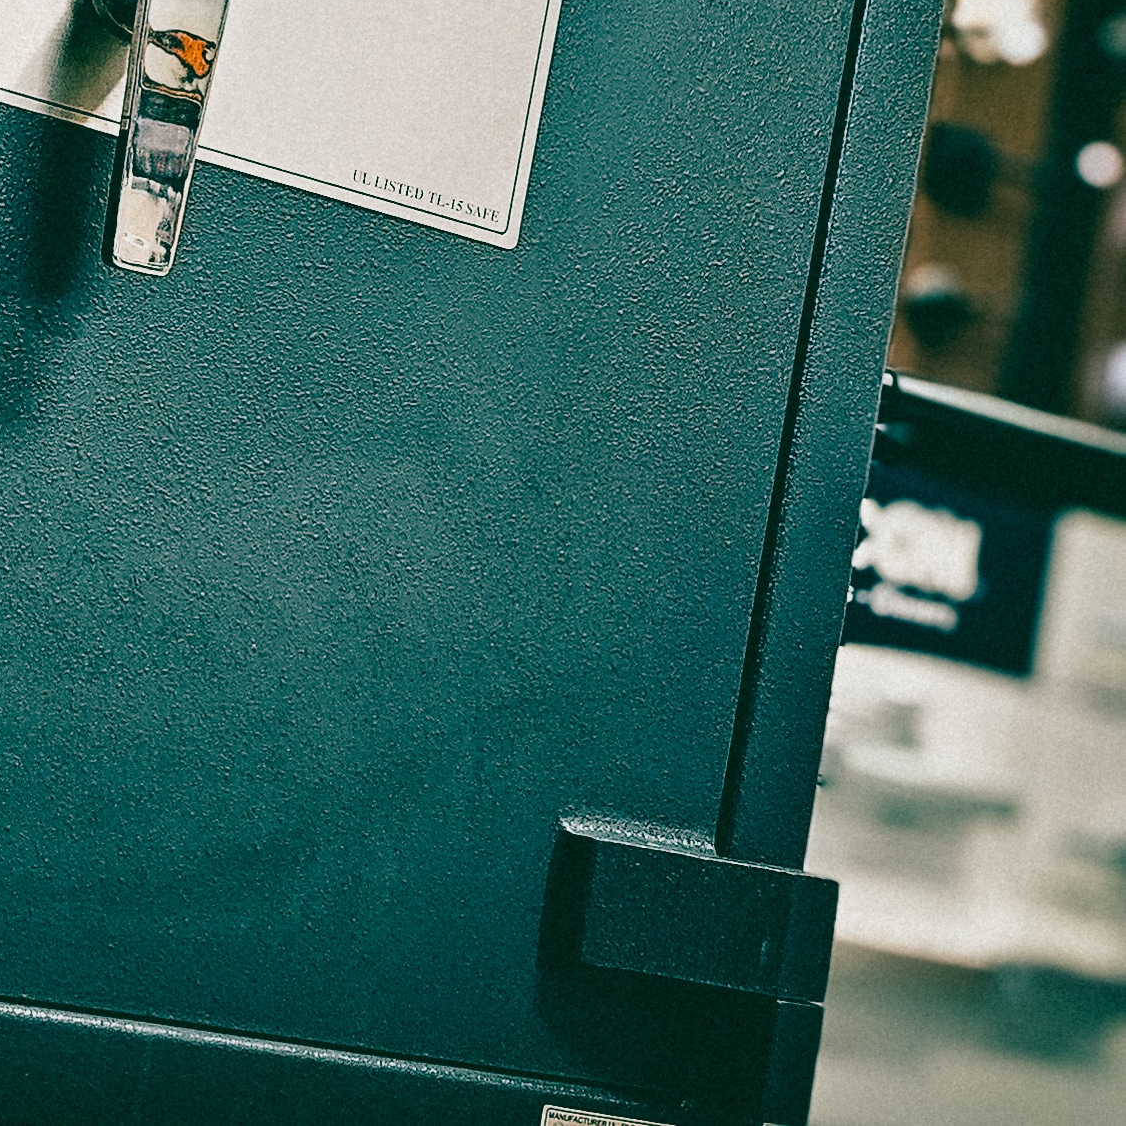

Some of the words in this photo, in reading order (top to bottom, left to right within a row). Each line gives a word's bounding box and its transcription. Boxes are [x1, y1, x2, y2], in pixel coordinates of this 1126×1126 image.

[353, 169, 371, 186] UL
[374, 176, 424, 201] LISTED
[428, 191, 463, 212] TL-15
[465, 203, 499, 223] SAFE
